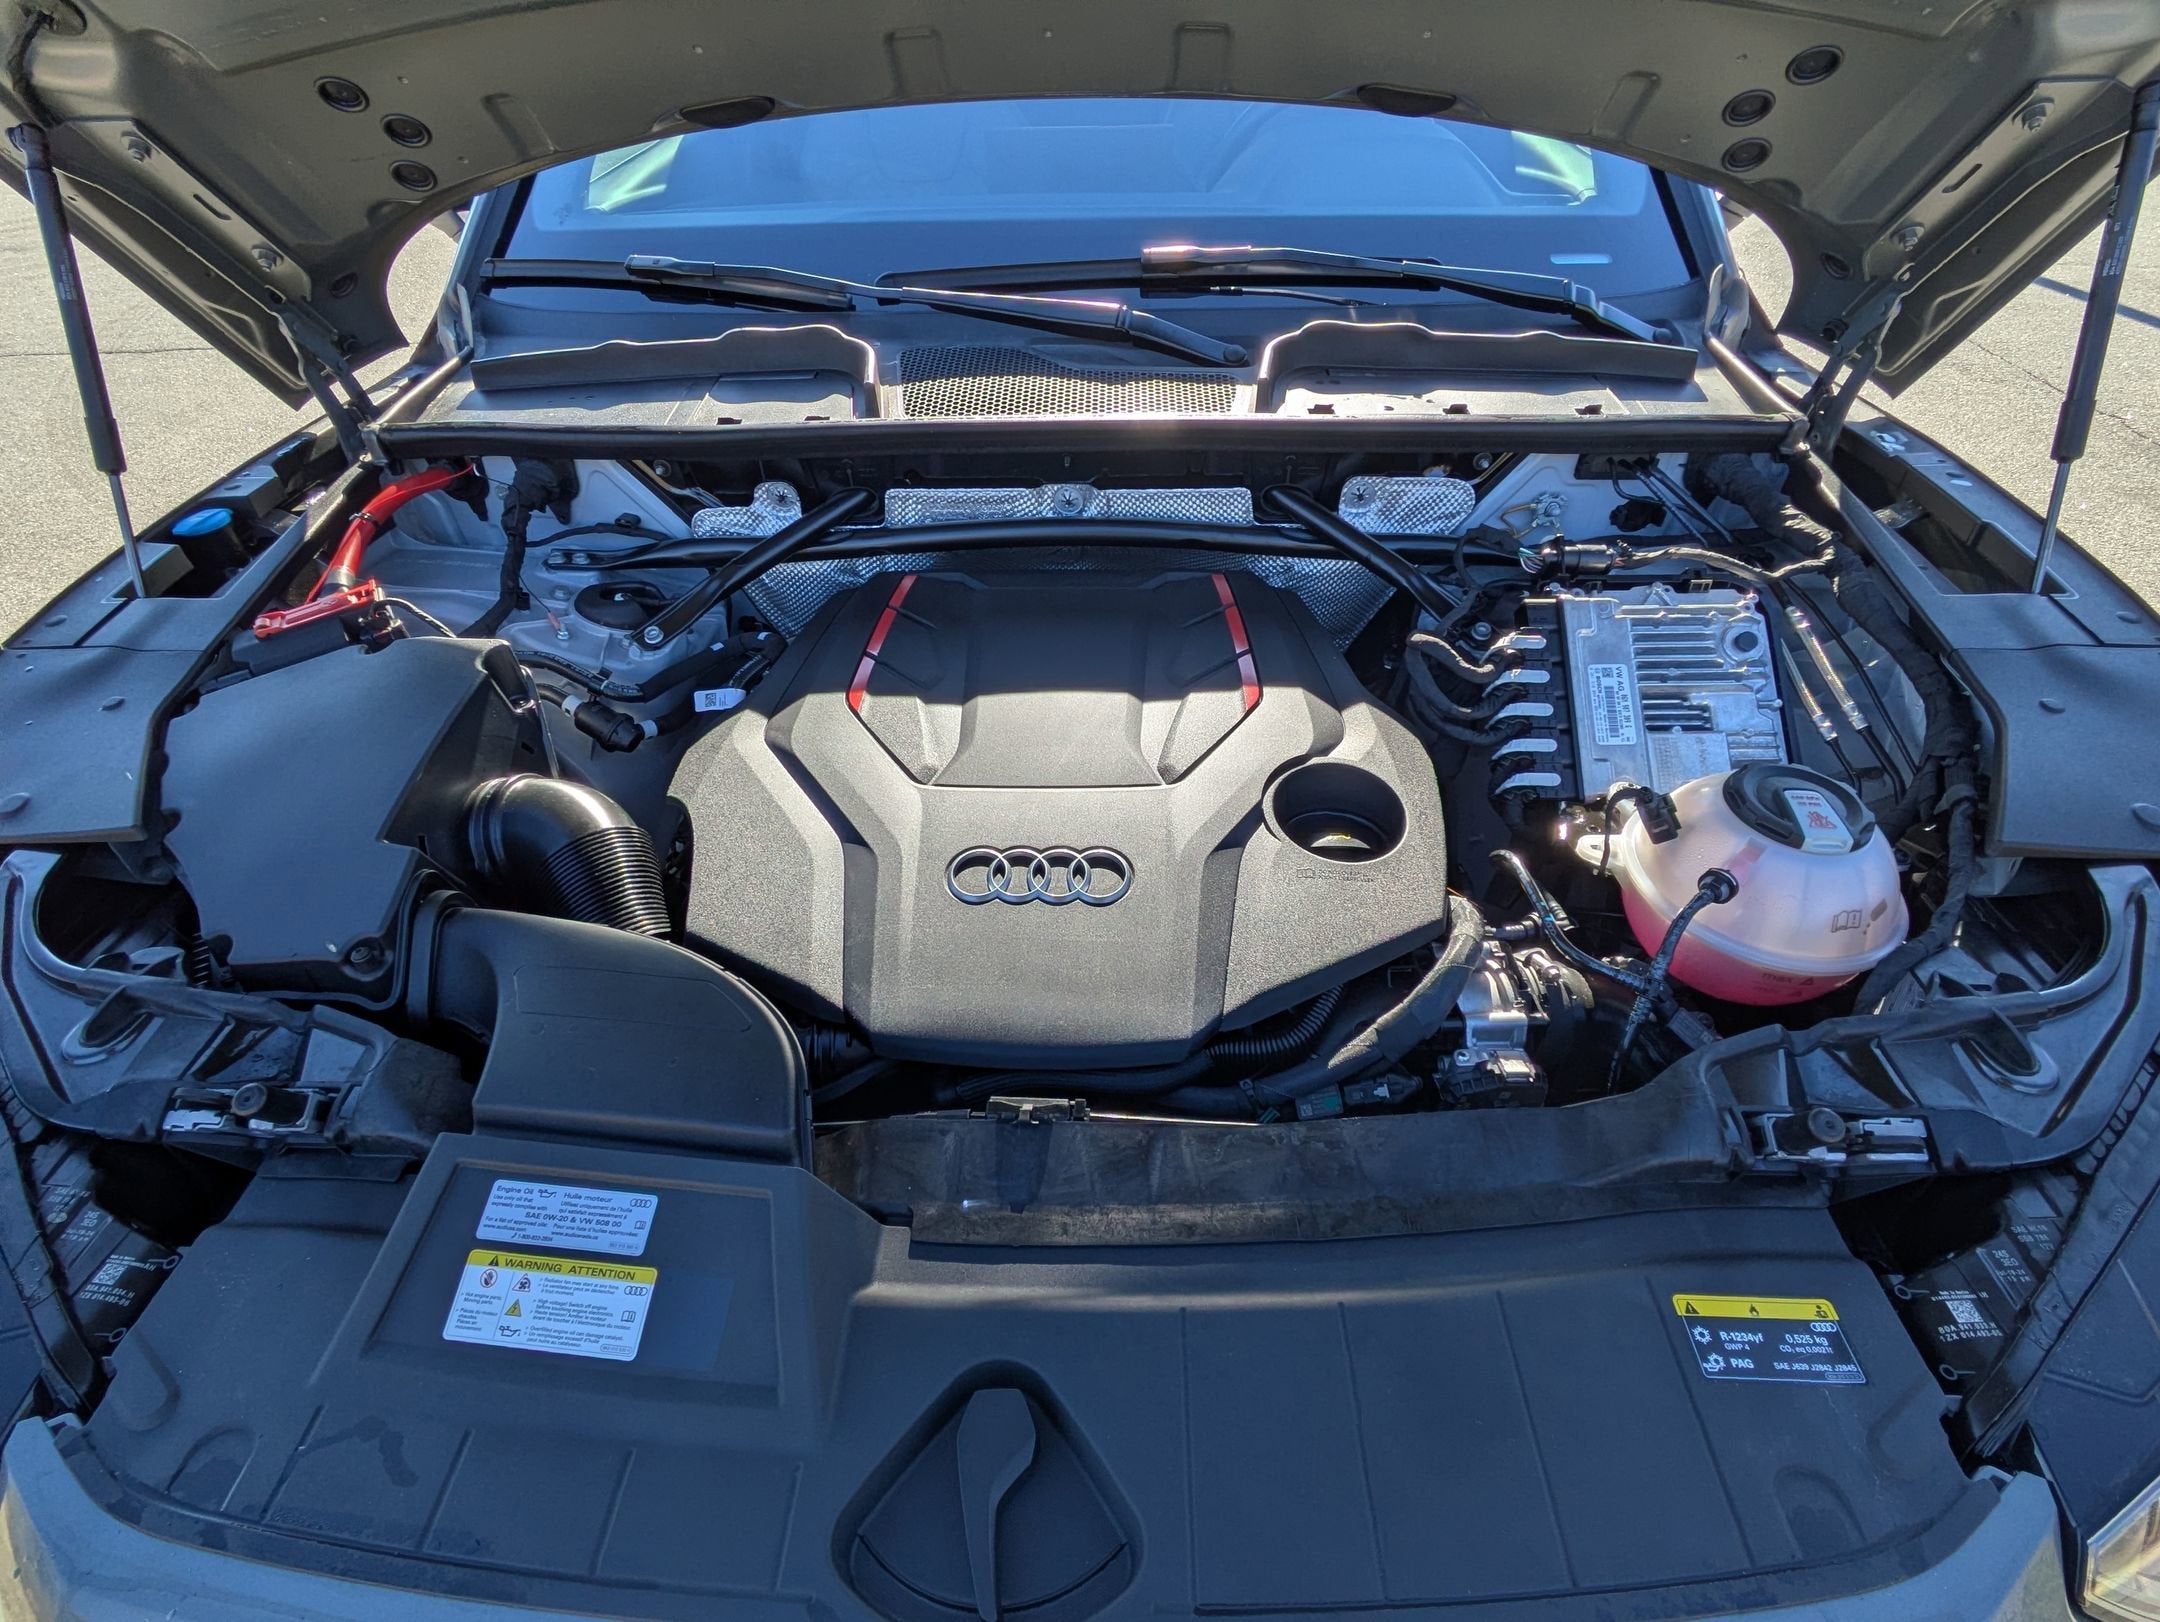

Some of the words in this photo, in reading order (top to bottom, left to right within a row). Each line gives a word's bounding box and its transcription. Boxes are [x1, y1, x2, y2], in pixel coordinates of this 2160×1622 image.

[1616, 666, 1624, 678] VW
[1617, 681, 1625, 692] AG
[497, 1186, 522, 1194] Engine
[543, 1214, 569, 1222] 0W-20
[504, 1258, 562, 1272] WARNING
[568, 1266, 636, 1280] ATTENTION
[1719, 1331, 1764, 1344] R-1234yf
[1785, 1334, 1813, 1344] 0,525
[1814, 1336, 1828, 1346] kg
[1730, 1358, 1754, 1369] PAG
